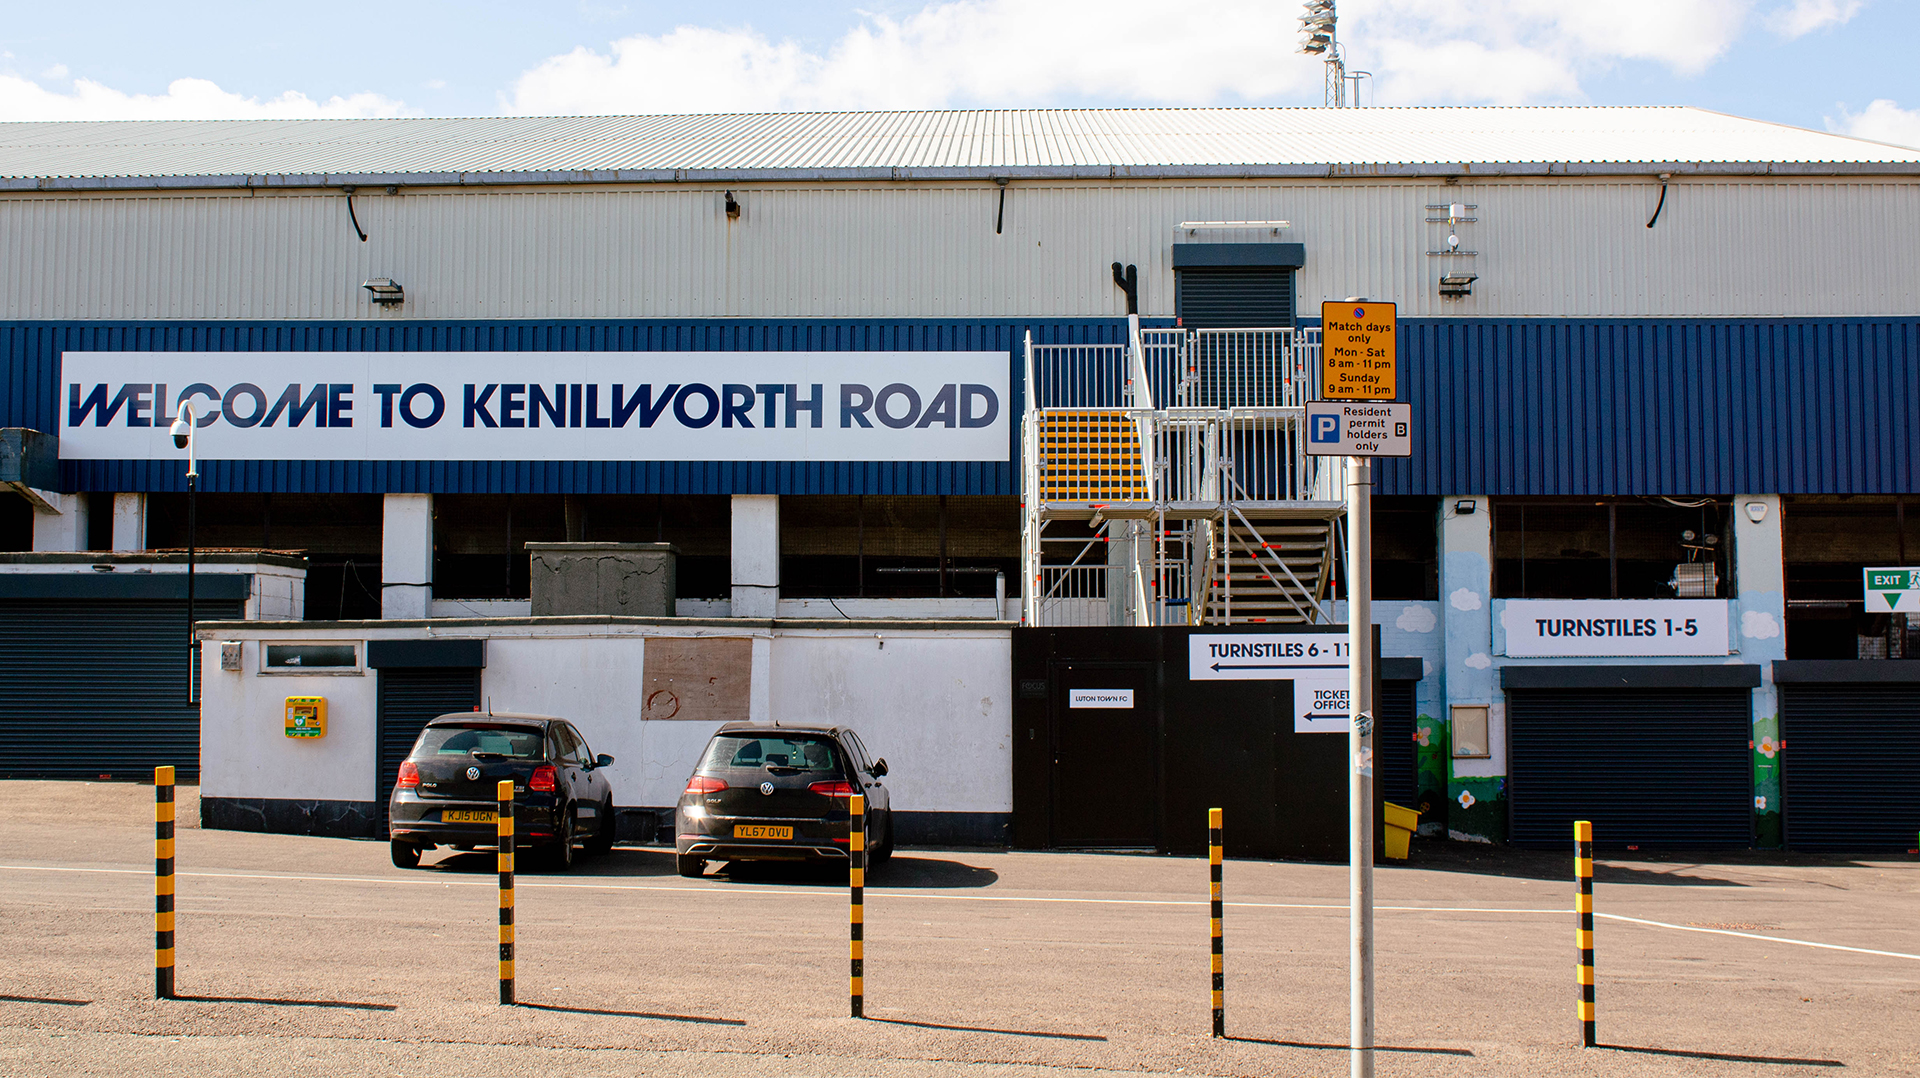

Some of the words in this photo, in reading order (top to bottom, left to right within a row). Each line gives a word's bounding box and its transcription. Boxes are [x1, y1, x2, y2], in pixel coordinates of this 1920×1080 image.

[1328, 321, 1362, 332] Match
[1366, 321, 1391, 333] days
[1348, 333, 1371, 344] only
[1334, 347, 1357, 357] Mon
[1366, 347, 1386, 357] Sat
[1328, 358, 1336, 368] 8
[1338, 360, 1354, 368] am
[1362, 359, 1372, 368] 11
[1374, 361, 1391, 370] pm
[1339, 372, 1380, 384] Sunday
[1328, 384, 1336, 394] 9
[1338, 386, 1354, 394] am
[1362, 384, 1372, 394] 11
[1374, 387, 1391, 396] pm
[68, 382, 354, 429] WELCOME
[373, 382, 446, 429] TO
[463, 383, 823, 428] KENILWORTH
[840, 383, 999, 429] ROAD
[1343, 406, 1392, 416] Resident
[1317, 417, 1336, 441] P
[1349, 418, 1385, 429] permit
[1347, 430, 1388, 440] holders
[1396, 424, 1406, 435] B
[1355, 441, 1379, 452] only
[1874, 575, 1901, 585] EXIT
[1535, 618, 1657, 637] TURNSTILES
[1663, 618, 1698, 637] 1-5
[1209, 643, 1304, 658] TURNSTILES
[1307, 643, 1319, 657] 6
[1333, 642, 1350, 657] 11
[1021, 682, 1046, 690] FOCUS
[1313, 690, 1350, 700] TICKET
[1313, 700, 1350, 710] OFFICE
[448, 811, 471, 821] KJ15
[473, 811, 493, 822] UGN
[739, 826, 766, 837] YL67
[768, 827, 789, 838] OVU
